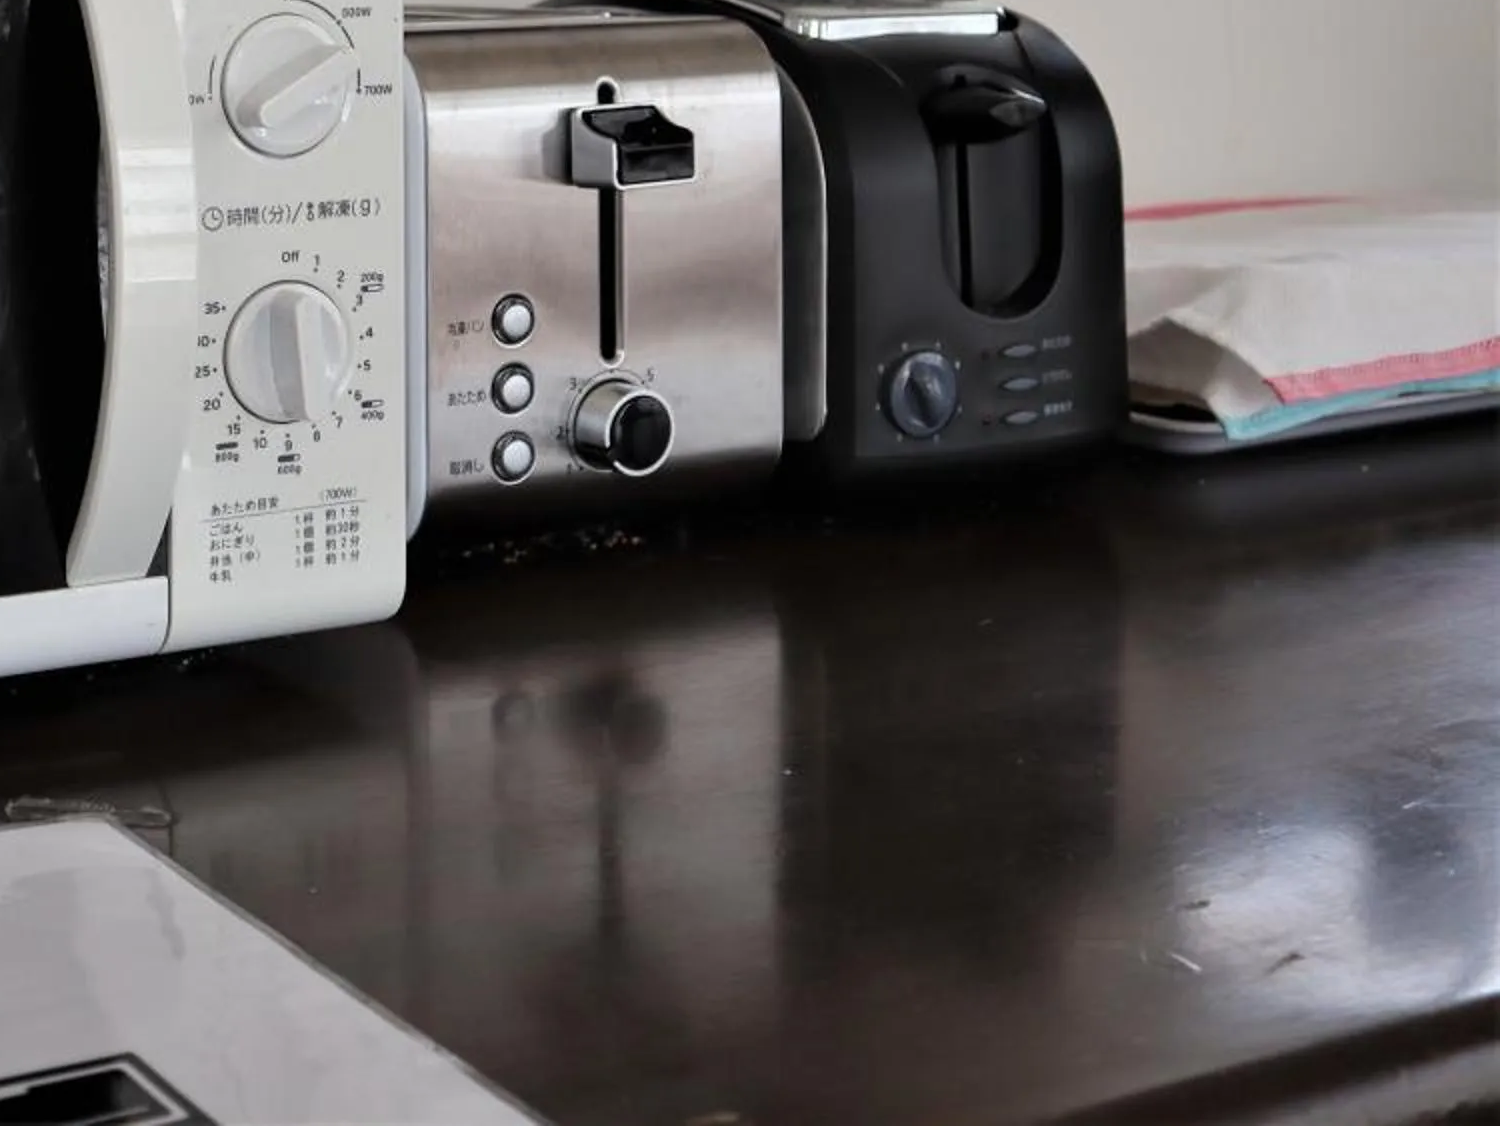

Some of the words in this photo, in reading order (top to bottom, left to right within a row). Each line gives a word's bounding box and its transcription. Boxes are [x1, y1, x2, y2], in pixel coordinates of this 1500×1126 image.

[337, 270, 345, 283] 2
[203, 301, 221, 315] 35
[365, 326, 373, 338] 4
[363, 359, 371, 371] 5
[203, 398, 221, 411] 20
[336, 415, 343, 428] 7
[228, 423, 241, 435] 15
[253, 437, 267, 449] 10
